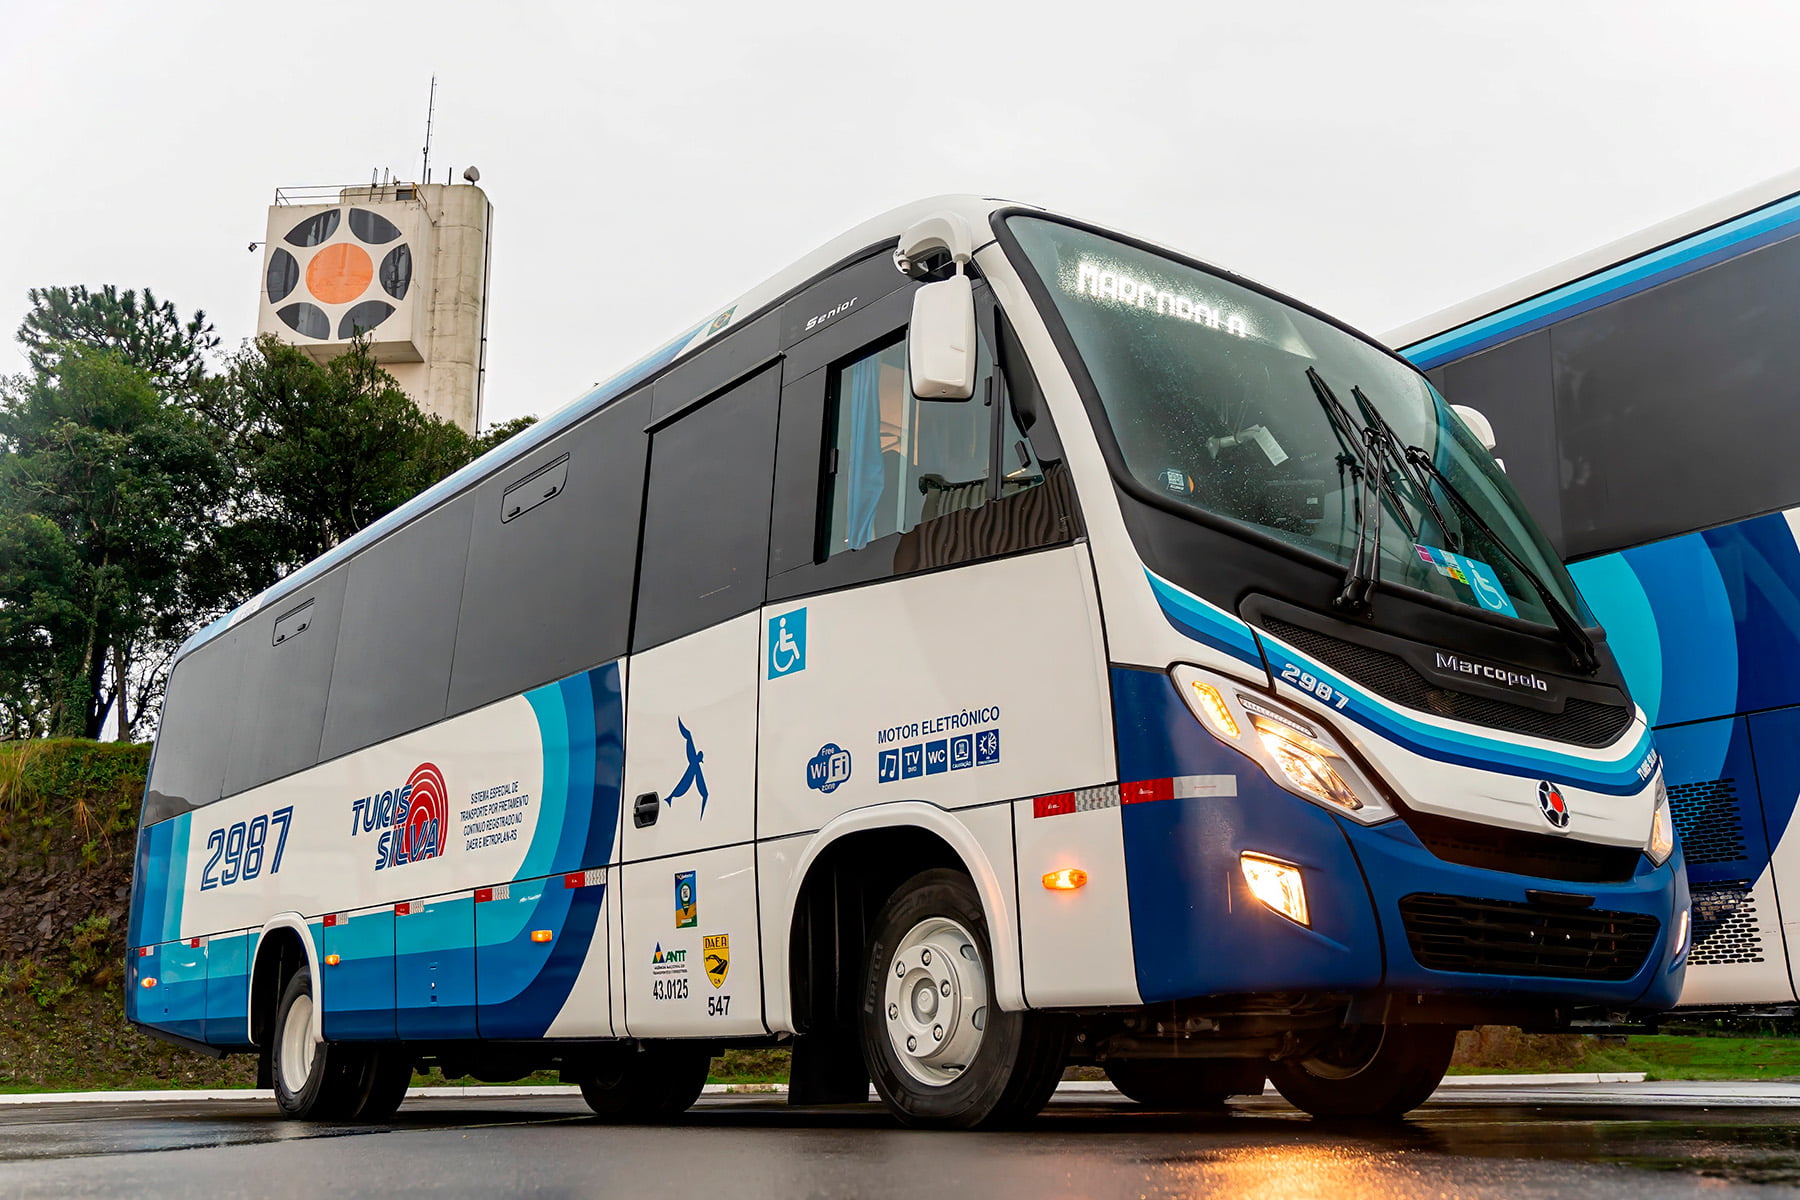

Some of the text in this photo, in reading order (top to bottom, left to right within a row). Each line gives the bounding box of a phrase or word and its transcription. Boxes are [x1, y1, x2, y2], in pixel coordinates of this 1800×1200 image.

[805, 296, 858, 331] Senior
[1281, 663, 1349, 709] 2987
[1436, 652, 1548, 692] Marcopolo
[878, 706, 1000, 744] MOTOR ELETRÔNICO
[905, 751, 920, 766] TV
[928, 750, 946, 764] WC
[512, 781, 519, 793] DE
[352, 784, 413, 836] TURIS
[200, 805, 294, 891] 2987
[375, 818, 439, 871] SILVA
[665, 950, 687, 963] ANTT
[705, 936, 728, 949] DAER
[653, 978, 689, 1000] 43.0125
[708, 995, 731, 1016] 547
